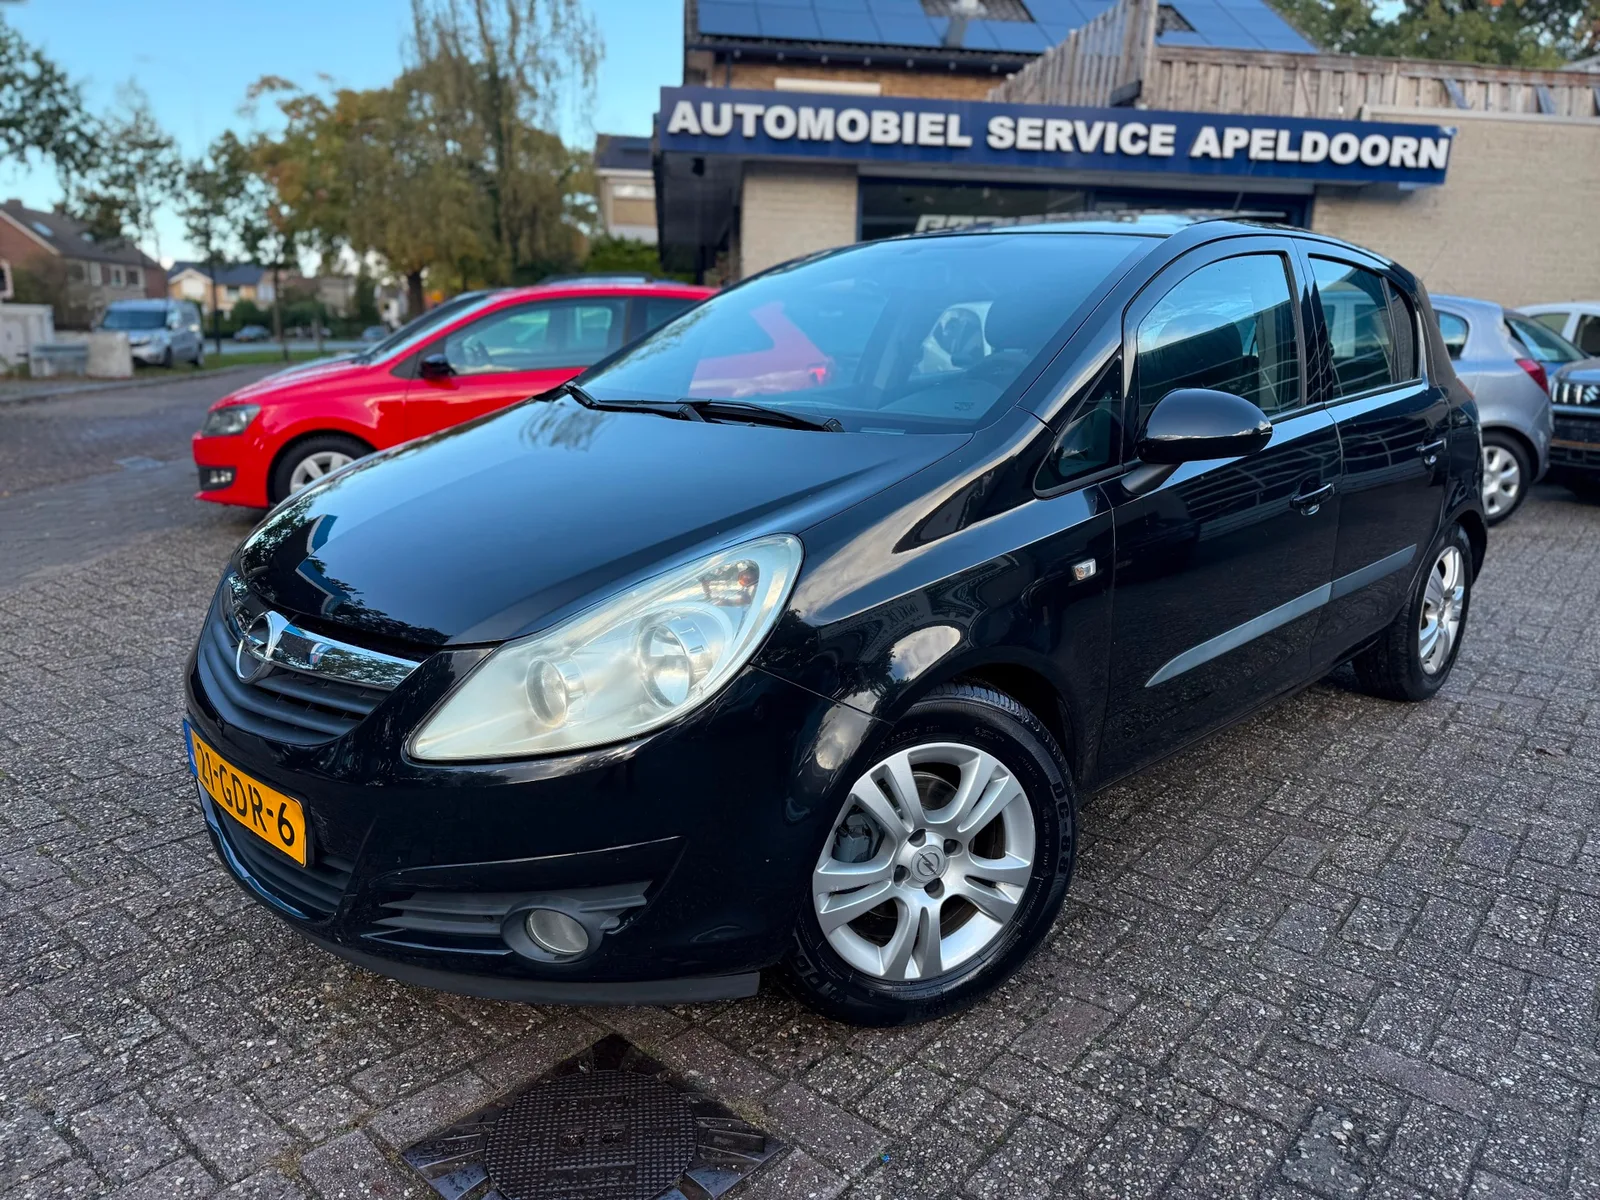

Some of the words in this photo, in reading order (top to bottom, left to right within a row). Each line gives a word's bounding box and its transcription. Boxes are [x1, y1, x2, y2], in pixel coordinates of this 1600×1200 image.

[667, 100, 973, 147] AUTOMOBIEL
[986, 115, 1177, 156] SERVICE
[1190, 126, 1450, 169] APELDOORN
[196, 741, 295, 847] 21-GDR-6
